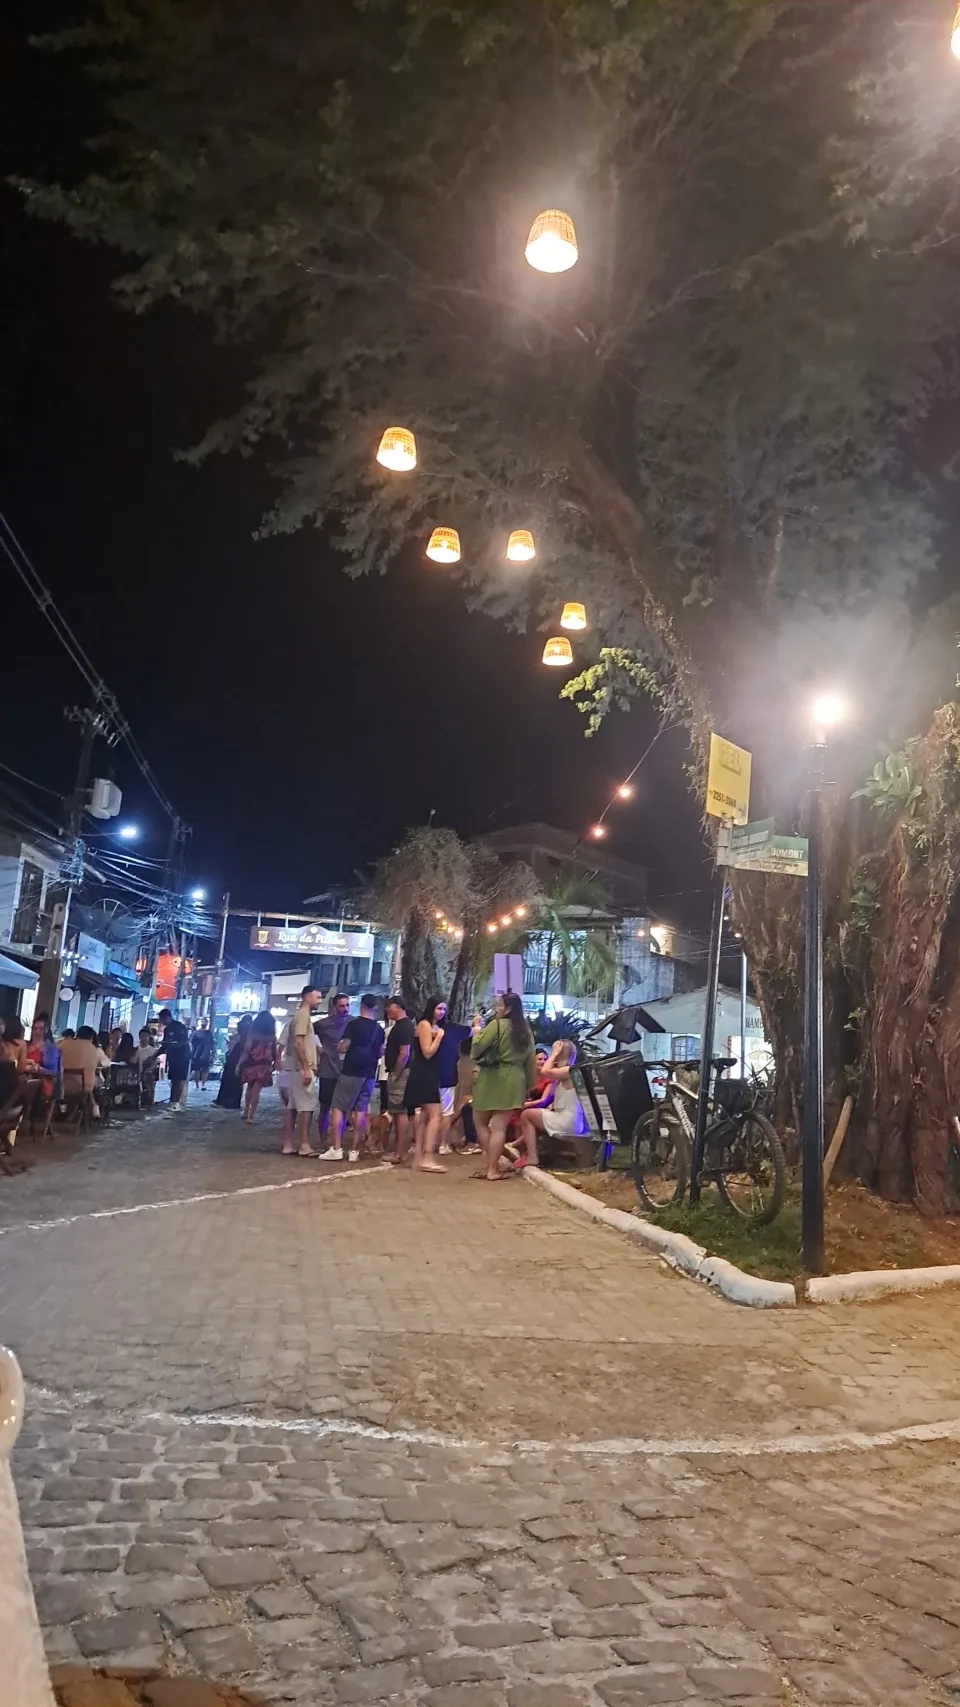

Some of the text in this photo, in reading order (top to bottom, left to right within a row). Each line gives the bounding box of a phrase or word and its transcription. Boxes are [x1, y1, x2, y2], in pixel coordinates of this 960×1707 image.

[771, 848, 805, 860] DUMONT
[278, 932, 298, 943] Rua
[299, 935, 313, 943] da
